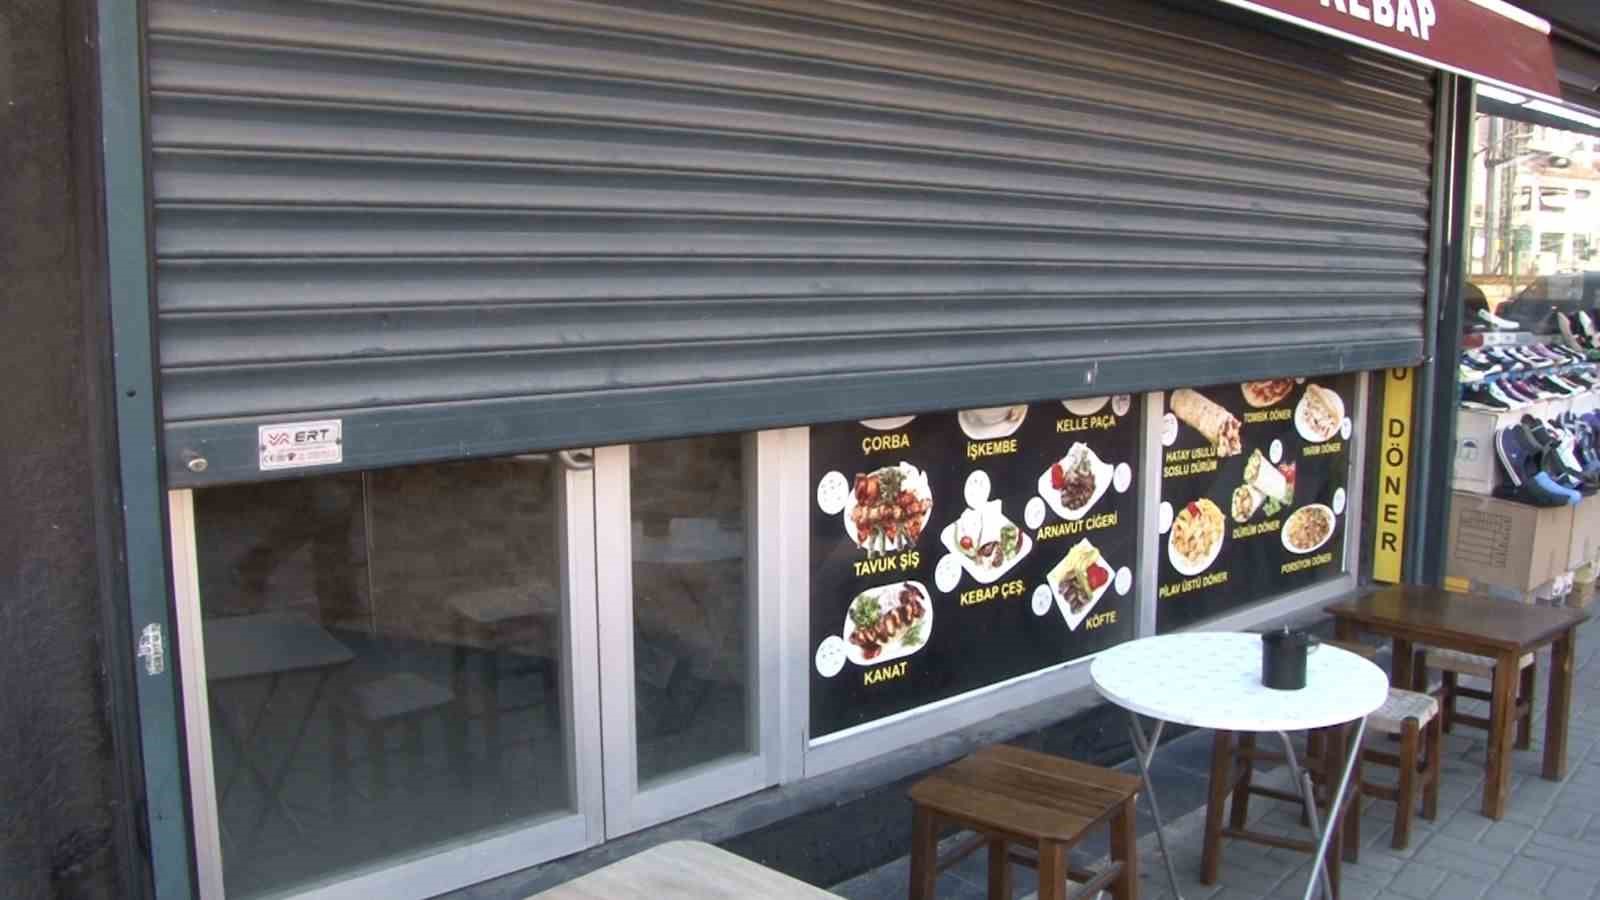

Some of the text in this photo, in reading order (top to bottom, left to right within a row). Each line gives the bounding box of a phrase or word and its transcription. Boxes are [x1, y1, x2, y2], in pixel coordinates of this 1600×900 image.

[1320, 0, 1437, 41] BAP
[1056, 415, 1117, 432] KELLE PAÇA
[295, 429, 329, 442] ERT
[861, 434, 911, 455] ÇORBA
[966, 439, 1018, 460] İŞKEMBE
[1381, 418, 1405, 552] DÖNER
[1037, 521, 1084, 541] ARNAVUT
[853, 551, 920, 577] TAVUK ŞİŞ
[959, 580, 1026, 606] KEBAP ÇEŞ.
[1085, 610, 1117, 632] KÖFTE
[863, 661, 908, 686] KANAT
